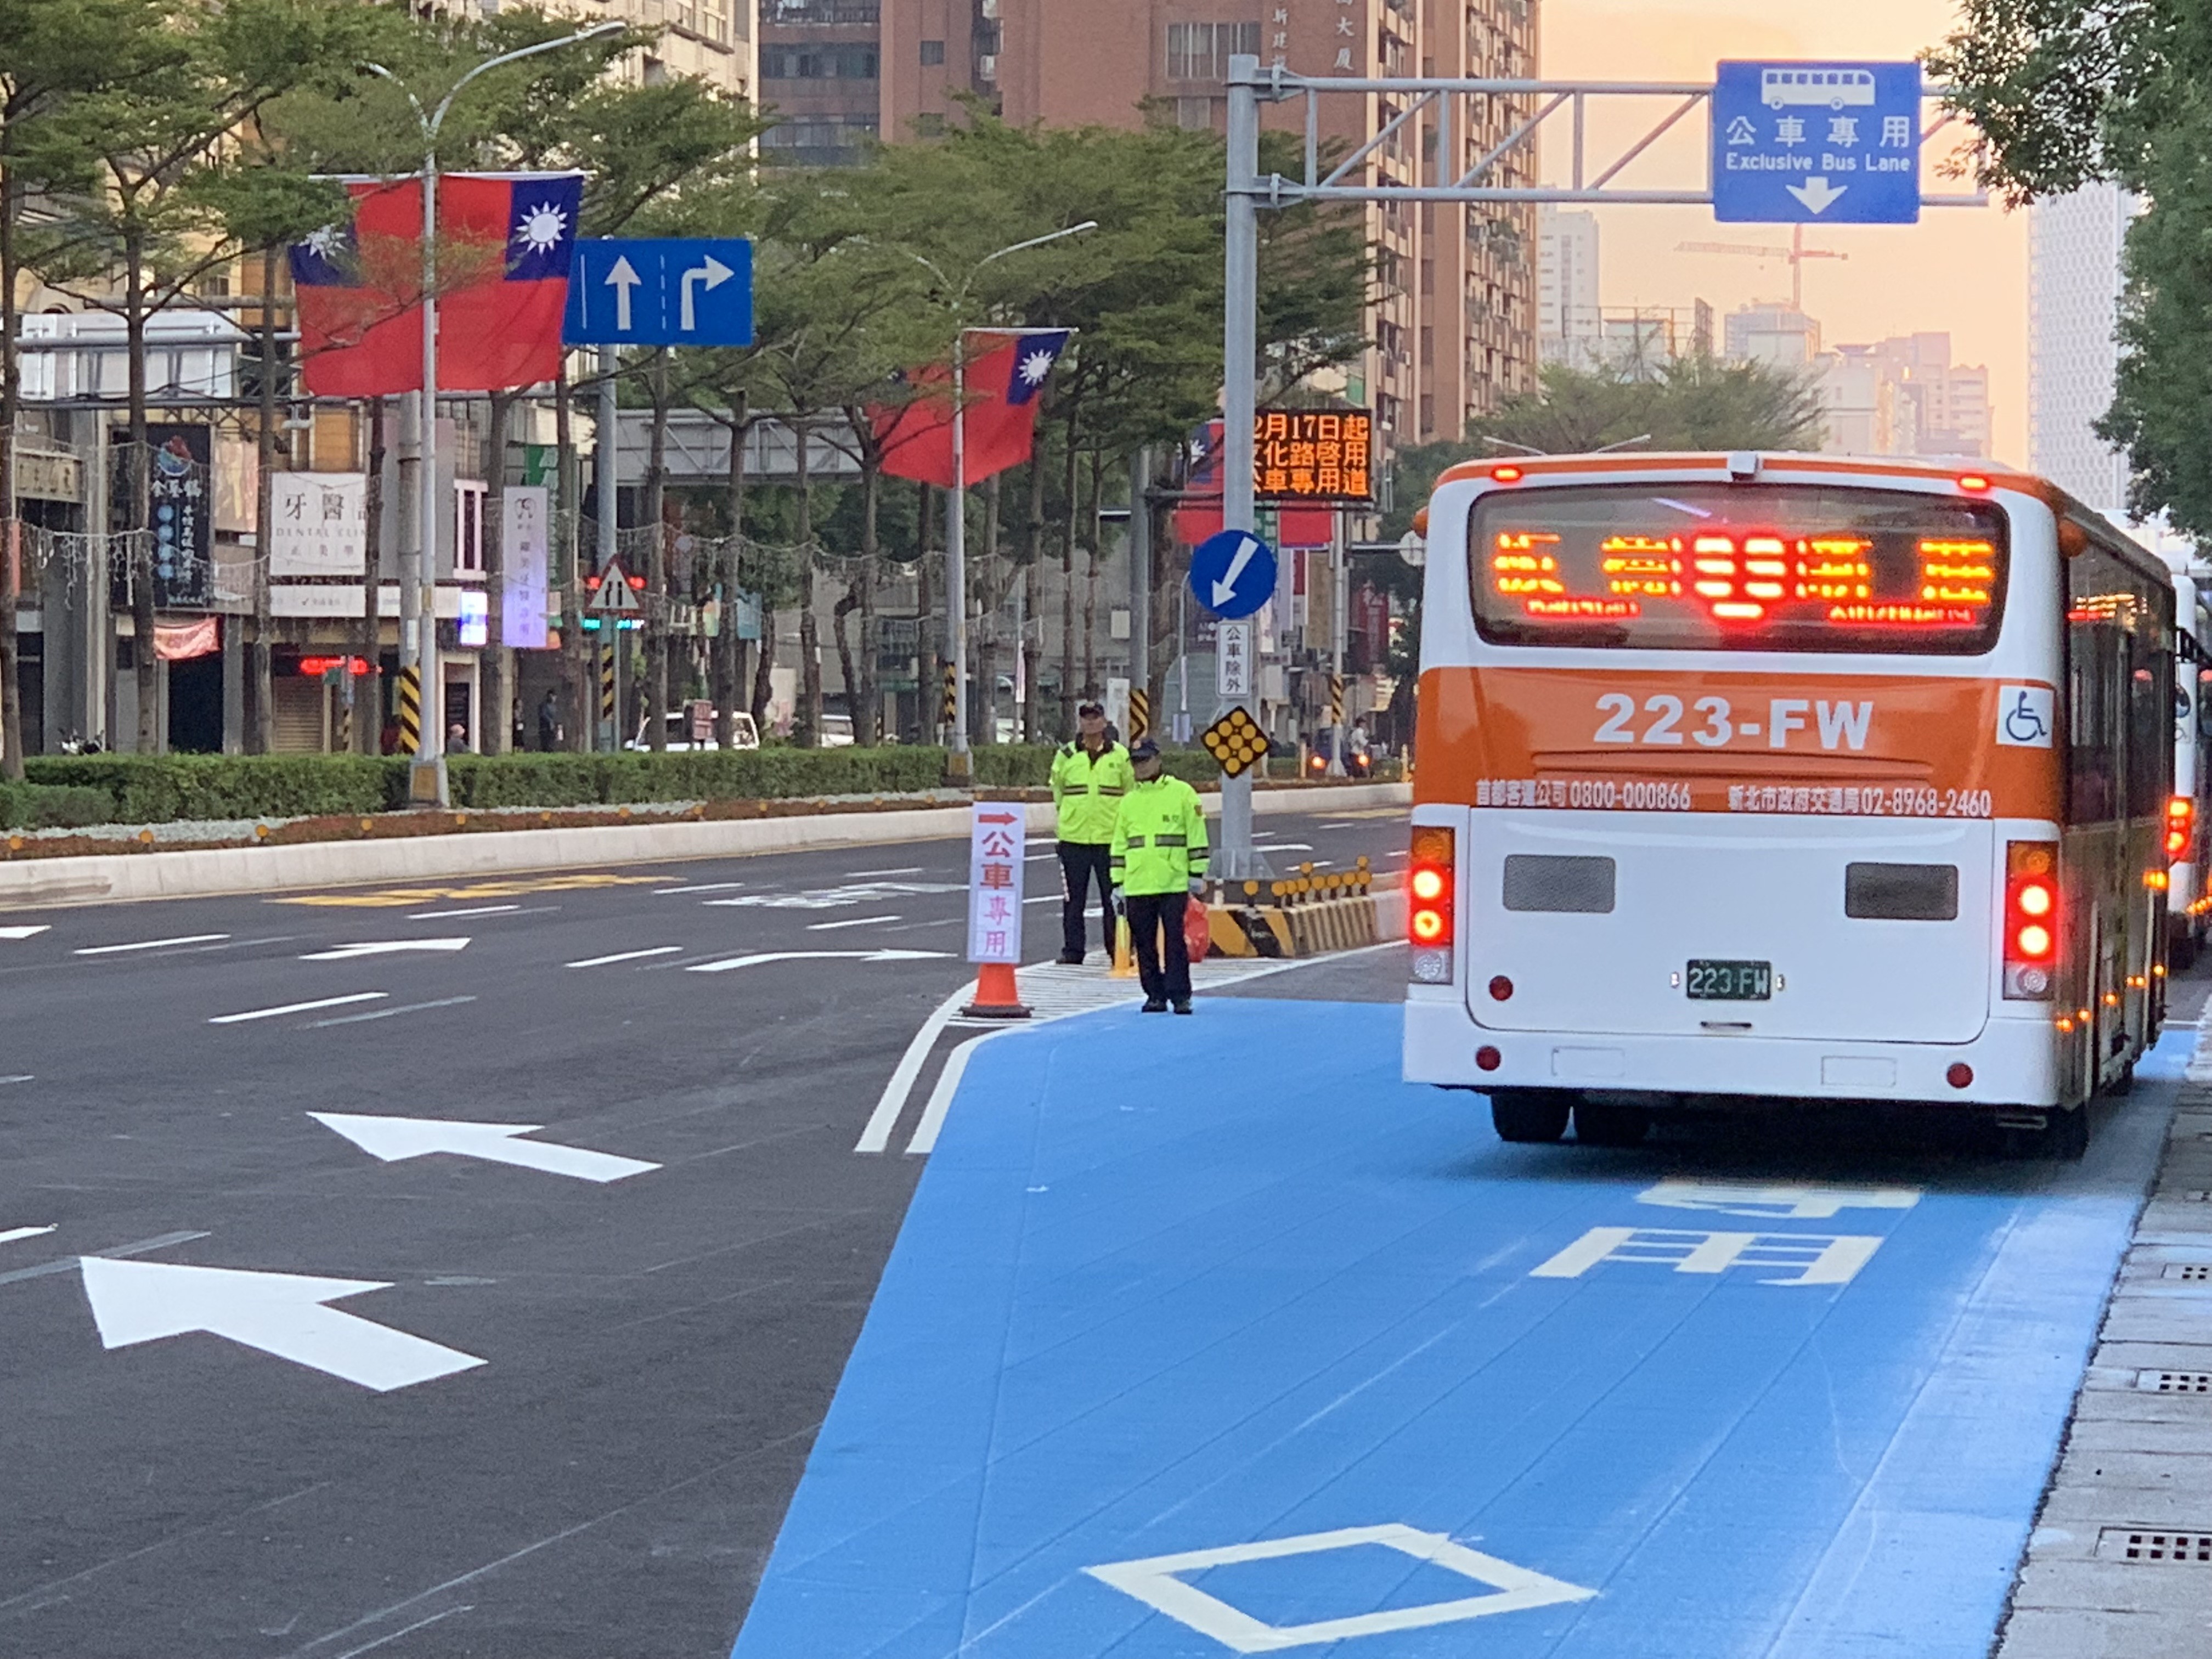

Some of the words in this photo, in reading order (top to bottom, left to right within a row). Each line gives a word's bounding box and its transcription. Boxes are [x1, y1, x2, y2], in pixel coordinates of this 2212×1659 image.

[1726, 115, 1910, 148] 公車專用
[1726, 152, 1813, 171] Exclusive
[1822, 153, 1857, 171] Bus
[1866, 154, 1910, 172] Lane
[1226, 627, 1242, 693] 公車除外
[1594, 693, 1874, 750] 223-FW
[979, 831, 1015, 957] 公車專用
